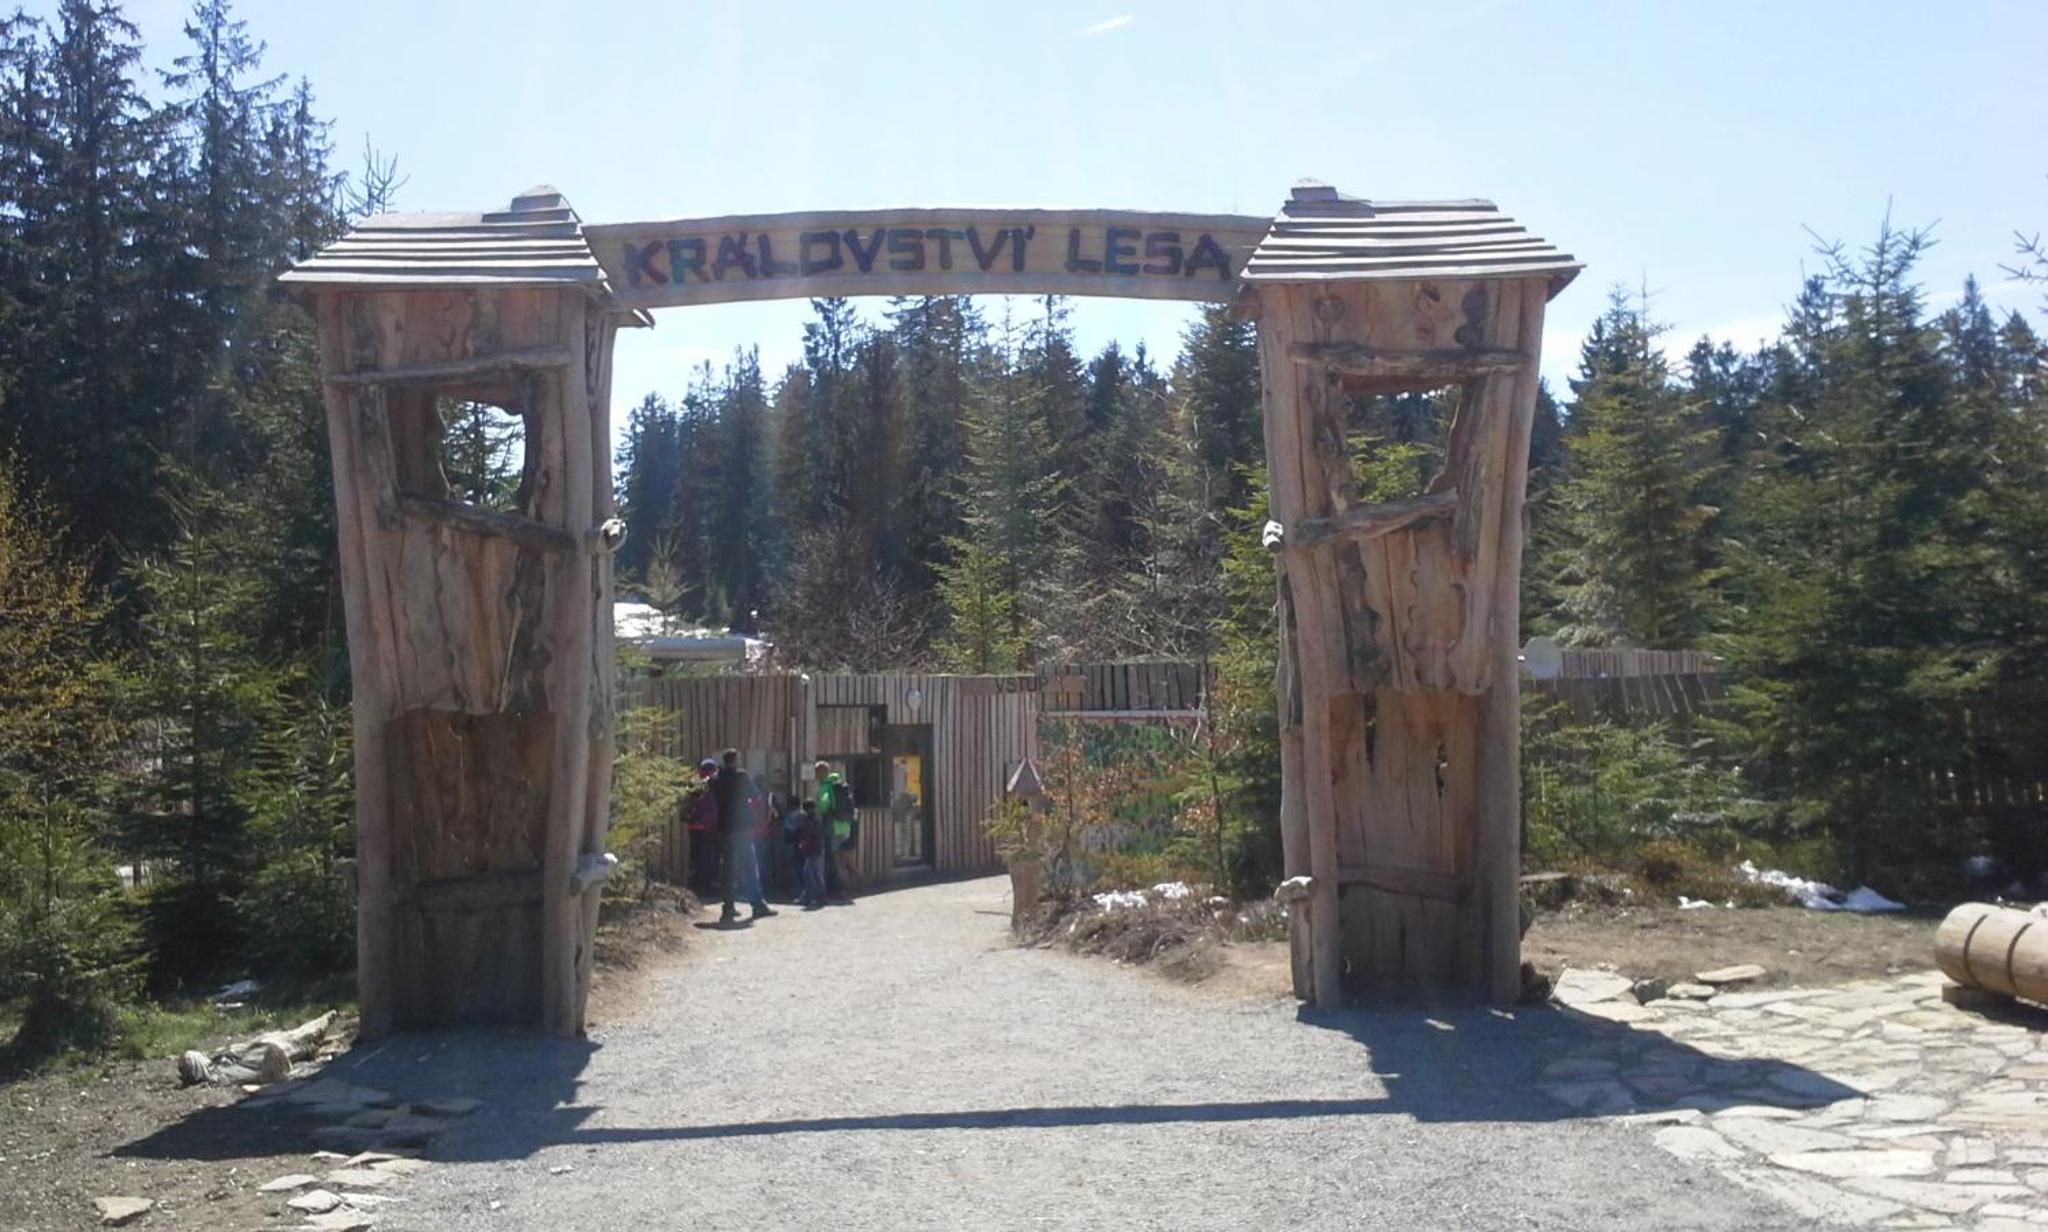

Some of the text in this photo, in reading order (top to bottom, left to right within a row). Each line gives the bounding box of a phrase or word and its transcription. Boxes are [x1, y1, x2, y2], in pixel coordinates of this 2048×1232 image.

[624, 224, 1233, 286] KRÁLOVSTVÍ LESA
[994, 677, 1049, 693] VSTUP
